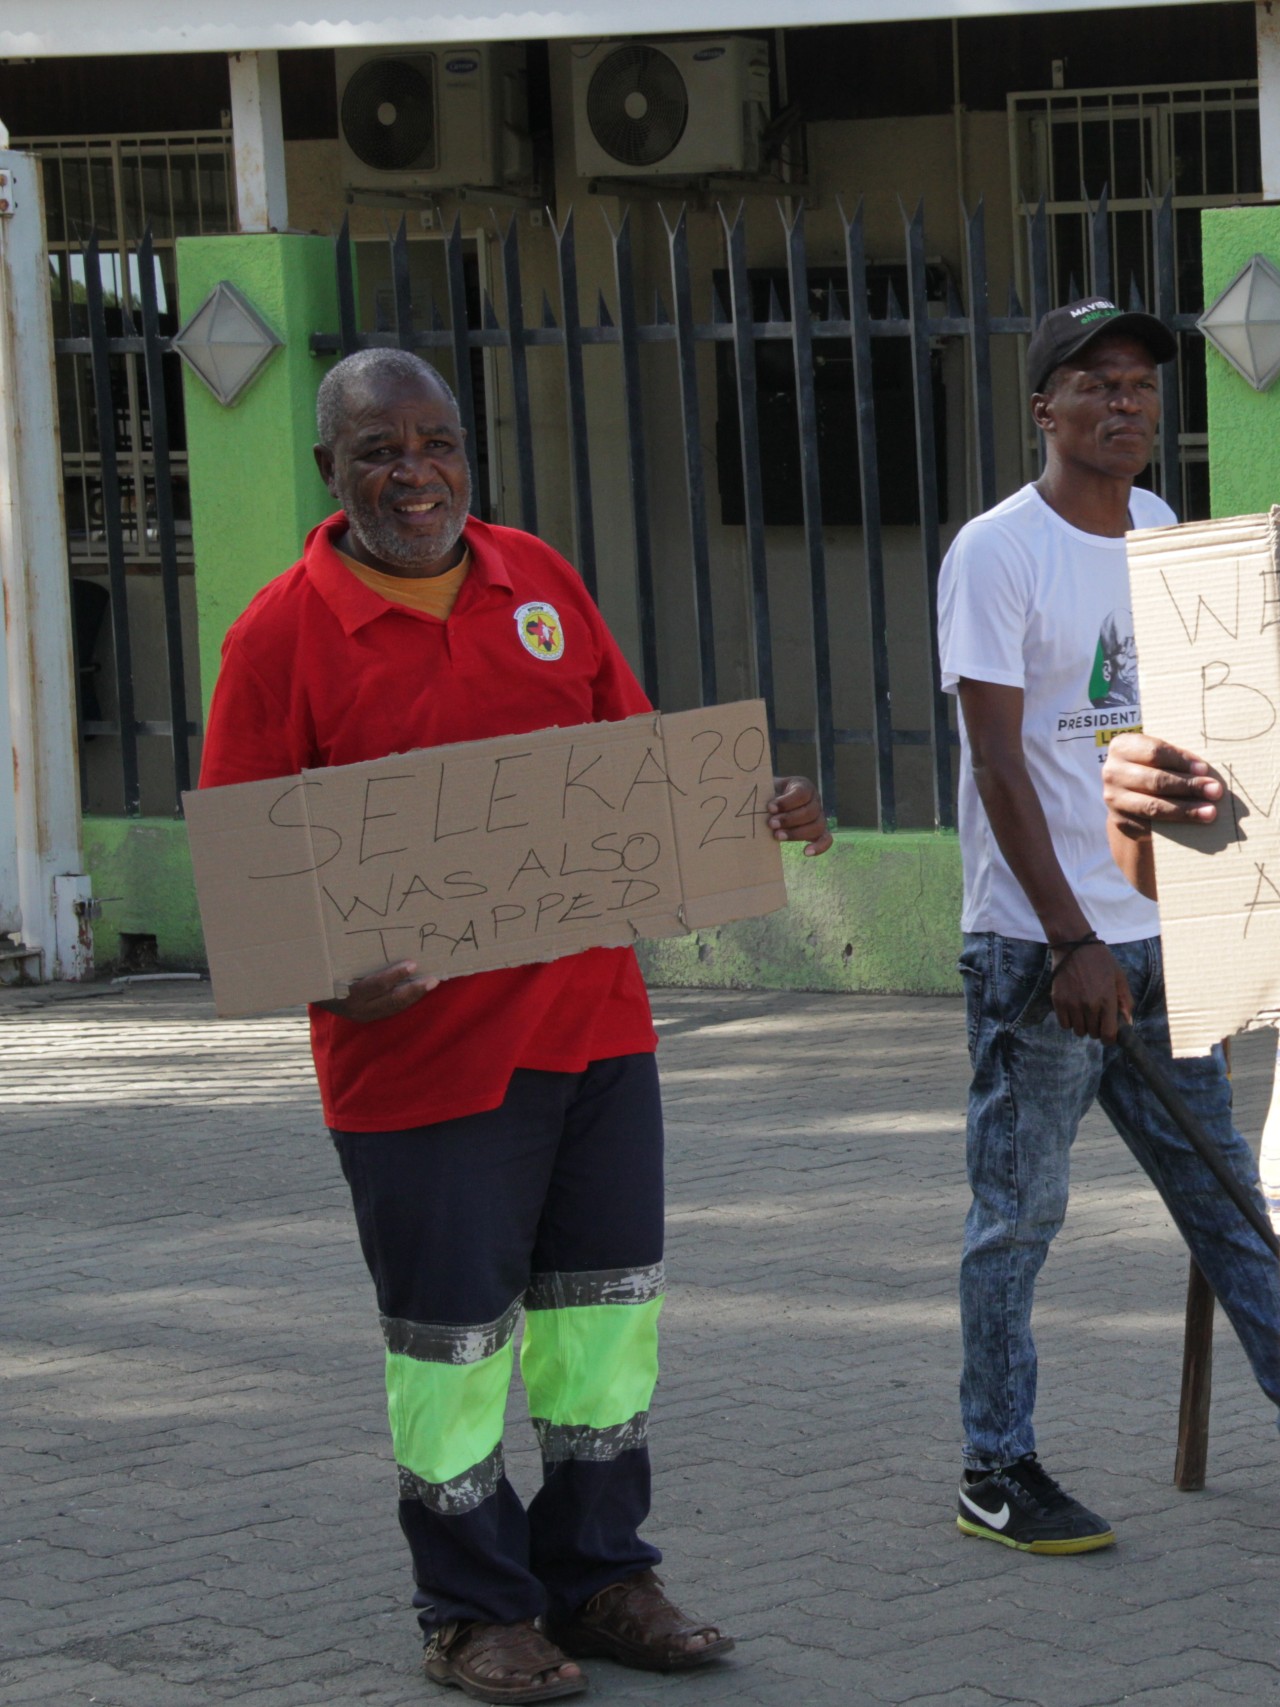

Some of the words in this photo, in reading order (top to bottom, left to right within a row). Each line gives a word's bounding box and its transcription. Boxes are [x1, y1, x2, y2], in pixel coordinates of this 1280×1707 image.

[691, 726, 765, 784] 20
[249, 744, 687, 879] SELEKA
[699, 783, 769, 849] 24
[322, 870, 488, 921] WAS
[508, 832, 661, 891] ALSO
[345, 878, 661, 963] TRAPPED
